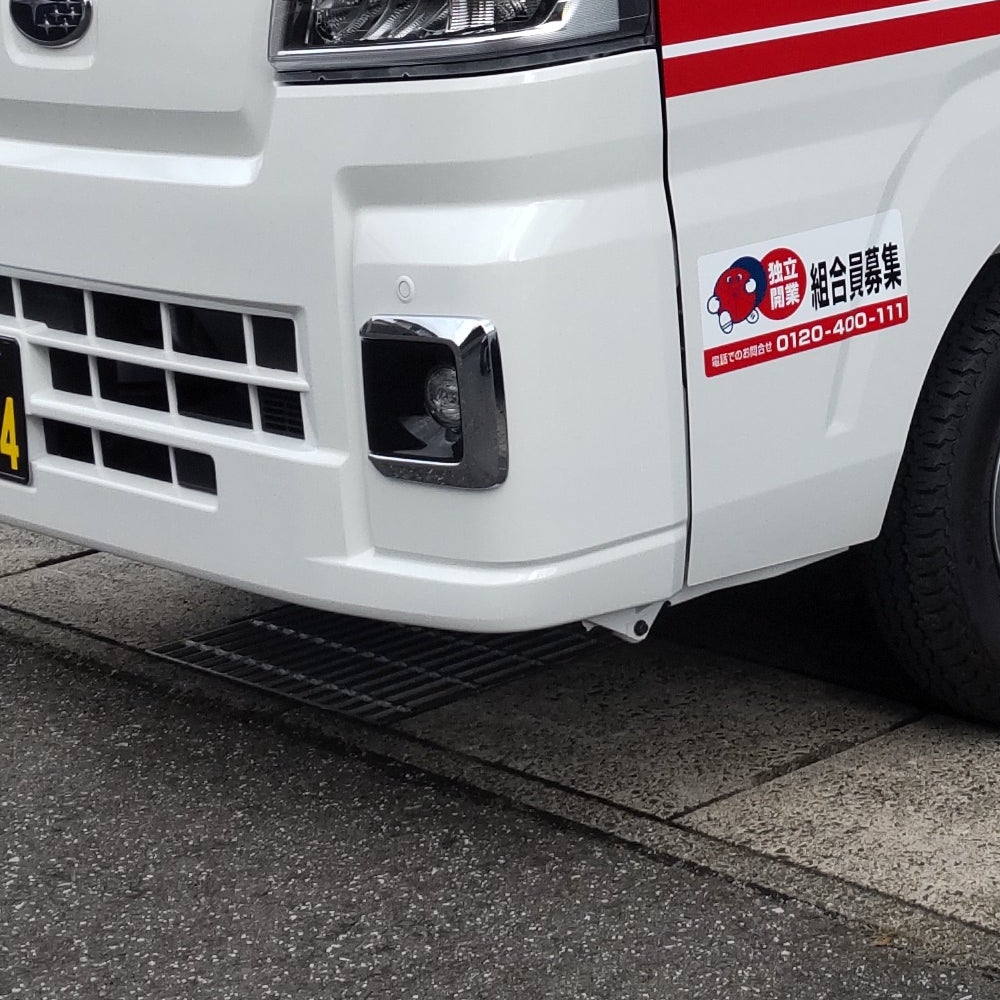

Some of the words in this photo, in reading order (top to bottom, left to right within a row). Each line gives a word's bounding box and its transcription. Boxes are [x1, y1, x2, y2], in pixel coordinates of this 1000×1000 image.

[767, 256, 800, 285] 独立
[810, 241, 903, 311] 組合員募集
[769, 281, 801, 311] 開業
[711, 341, 773, 368] 電話でのお問合せ
[776, 302, 904, 352] 0120-400-111
